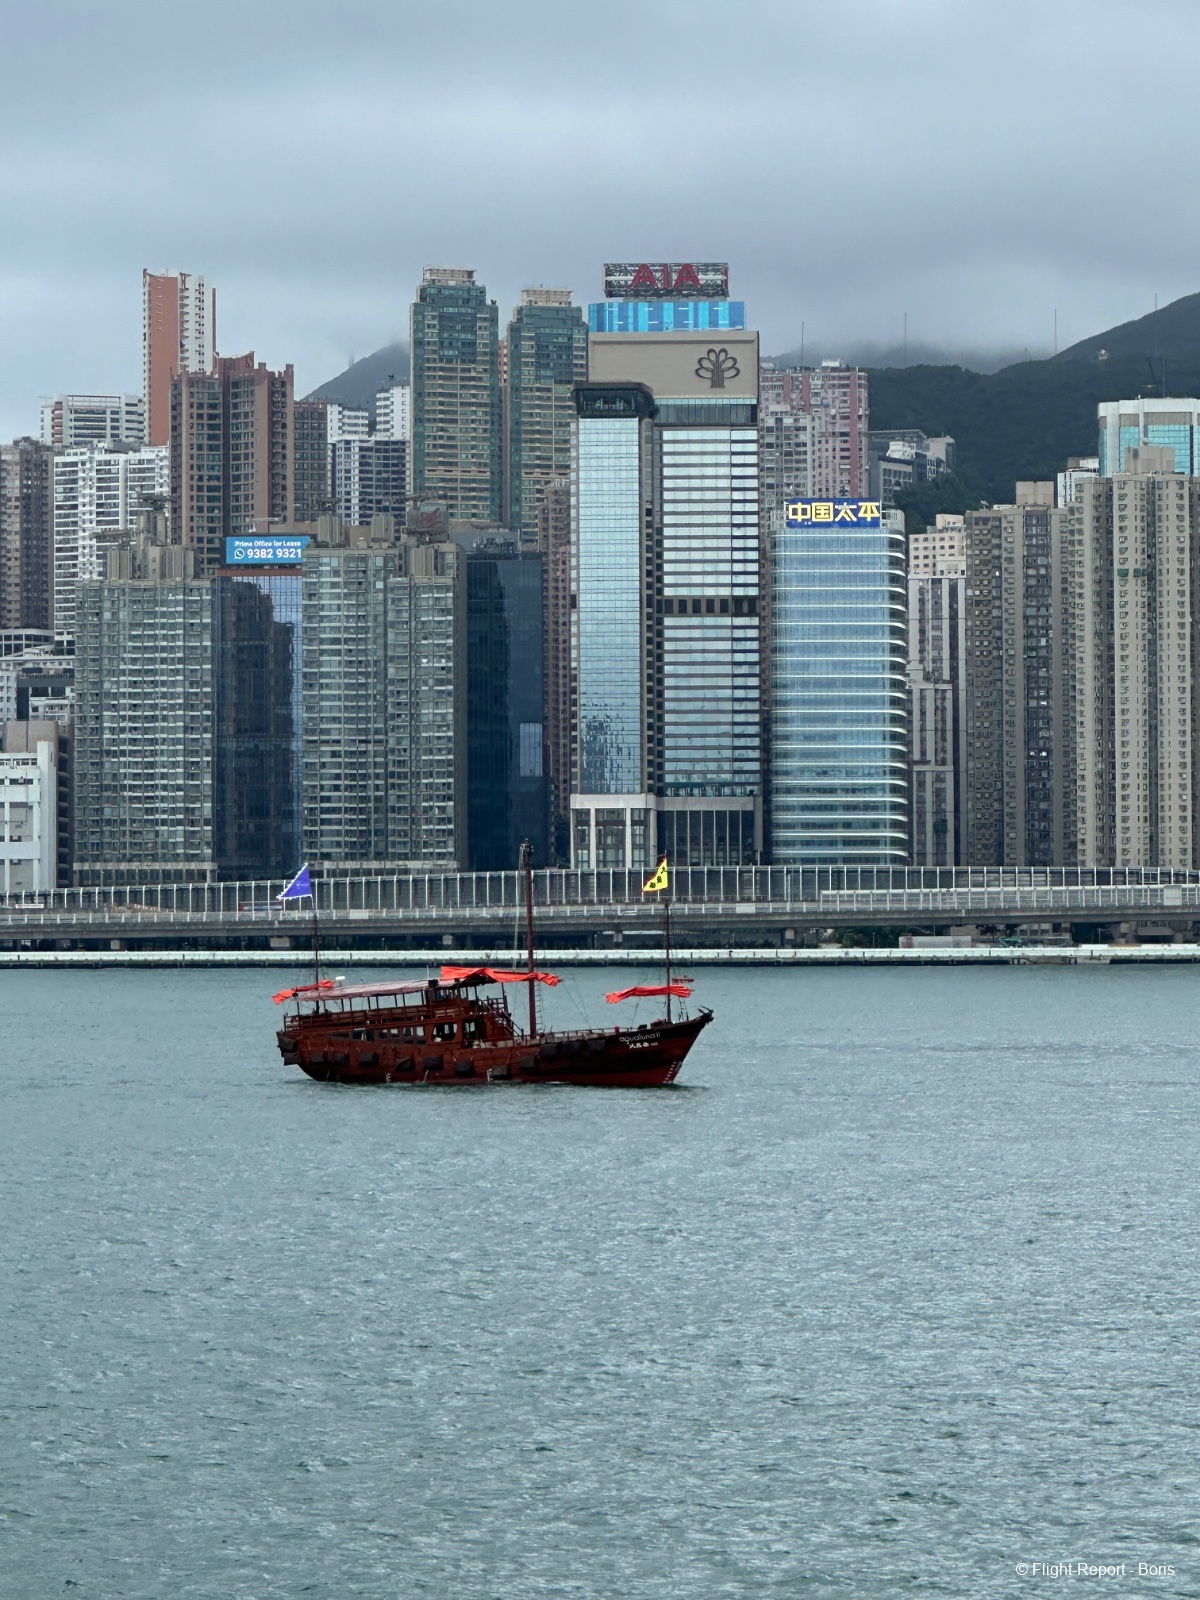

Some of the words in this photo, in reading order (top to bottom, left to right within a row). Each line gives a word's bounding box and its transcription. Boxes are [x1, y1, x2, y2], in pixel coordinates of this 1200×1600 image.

[630, 263, 701, 289] AIA
[788, 502, 880, 522] 中国太平
[247, 548, 273, 559] 9382
[276, 548, 302, 558] 9321
